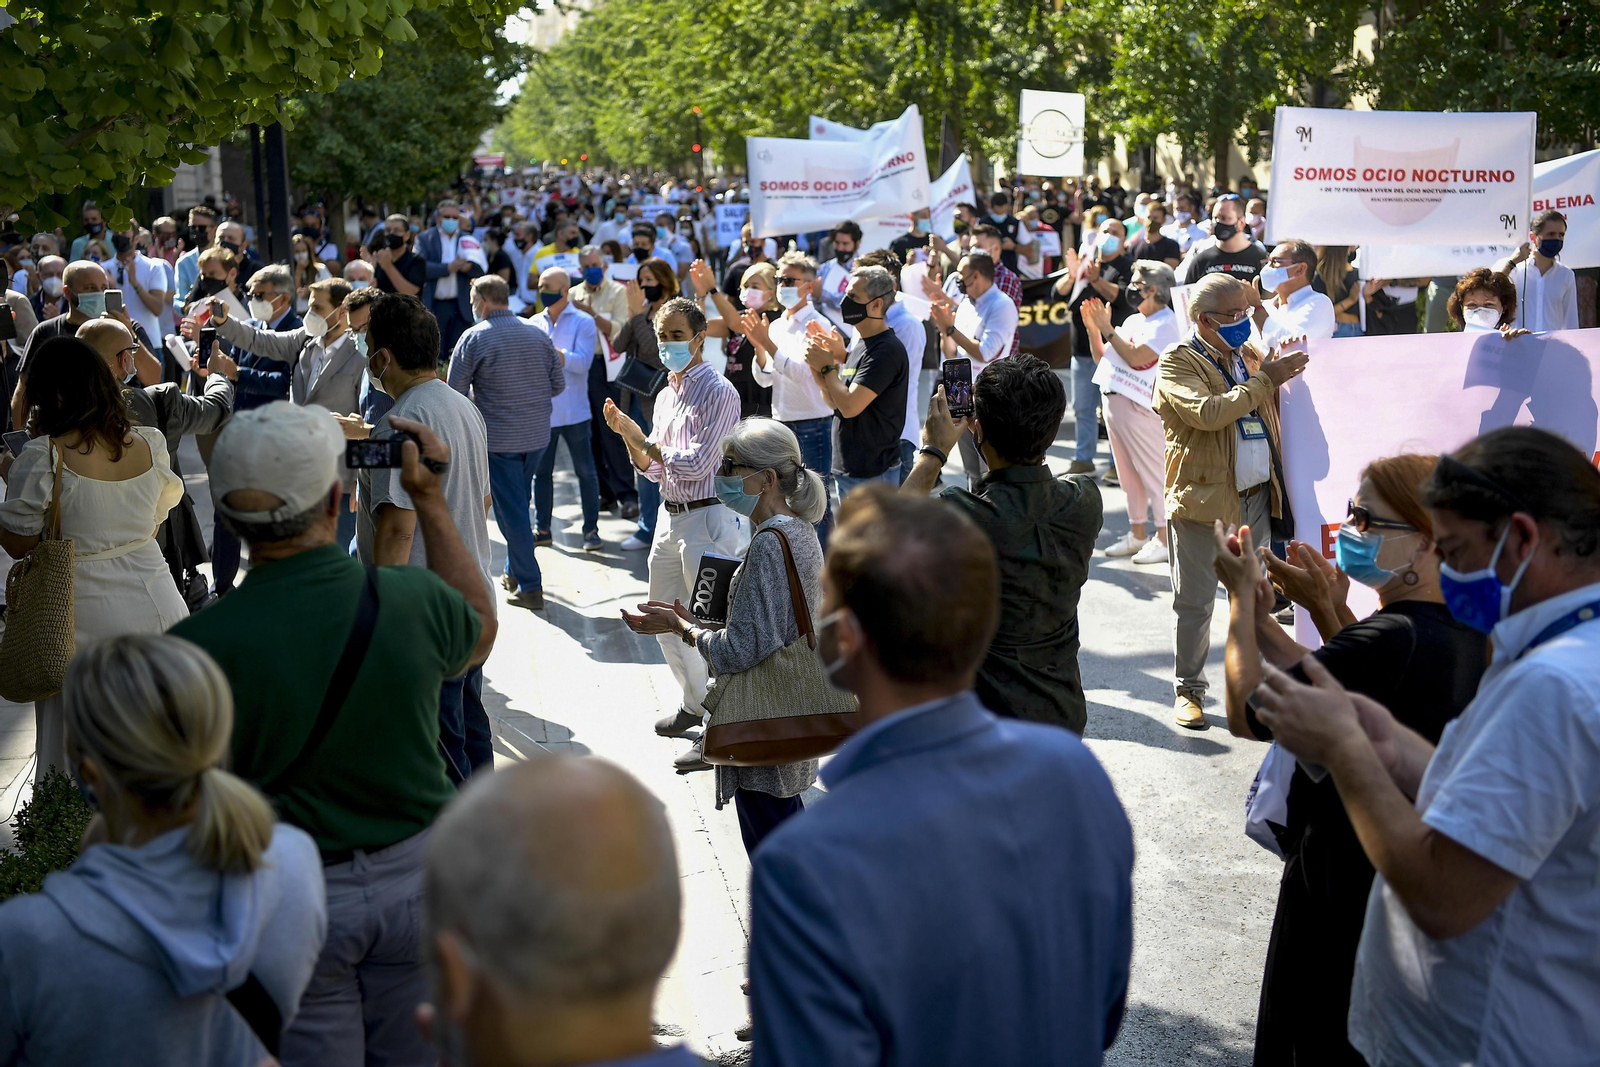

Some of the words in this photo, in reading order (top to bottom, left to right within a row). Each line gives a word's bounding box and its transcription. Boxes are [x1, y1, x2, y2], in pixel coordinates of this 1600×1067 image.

[1293, 167, 1357, 181] SOMOS
[1362, 168, 1406, 182] OCIO
[1411, 169, 1516, 183] NOCTURNO
[759, 180, 809, 191] SOMOS
[813, 180, 848, 191] OCIO
[693, 567, 718, 615] 2020
